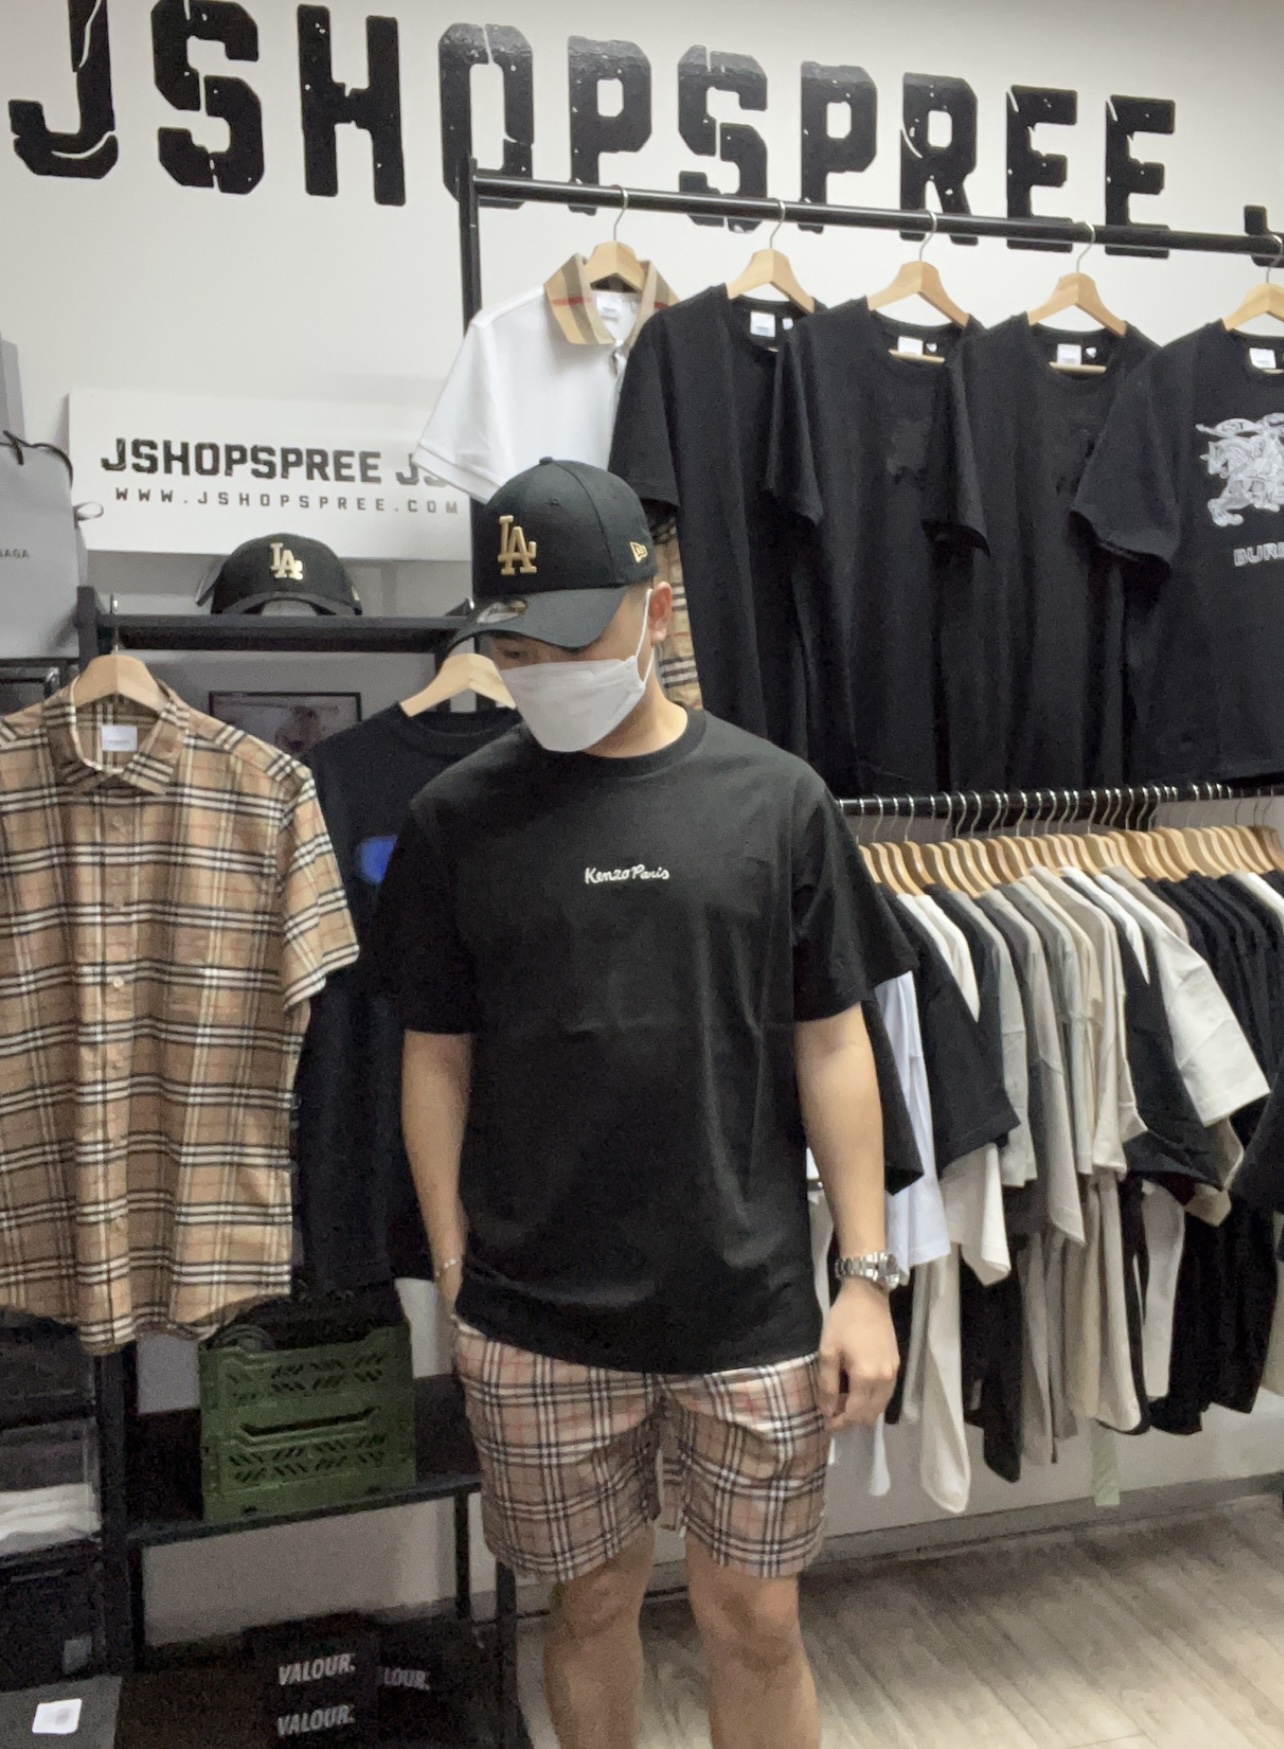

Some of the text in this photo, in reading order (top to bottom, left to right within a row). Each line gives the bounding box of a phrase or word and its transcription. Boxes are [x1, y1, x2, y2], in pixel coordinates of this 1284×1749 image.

[8, 0, 1175, 258] JSHOPSPREE
[101, 438, 382, 484] JSHOPSPREE
[115, 487, 458, 514] WWW.JSHOPSPREE.COM
[270, 542, 303, 580] LA
[498, 515, 537, 576] LA
[378, 1666, 430, 1691] LOUR.
